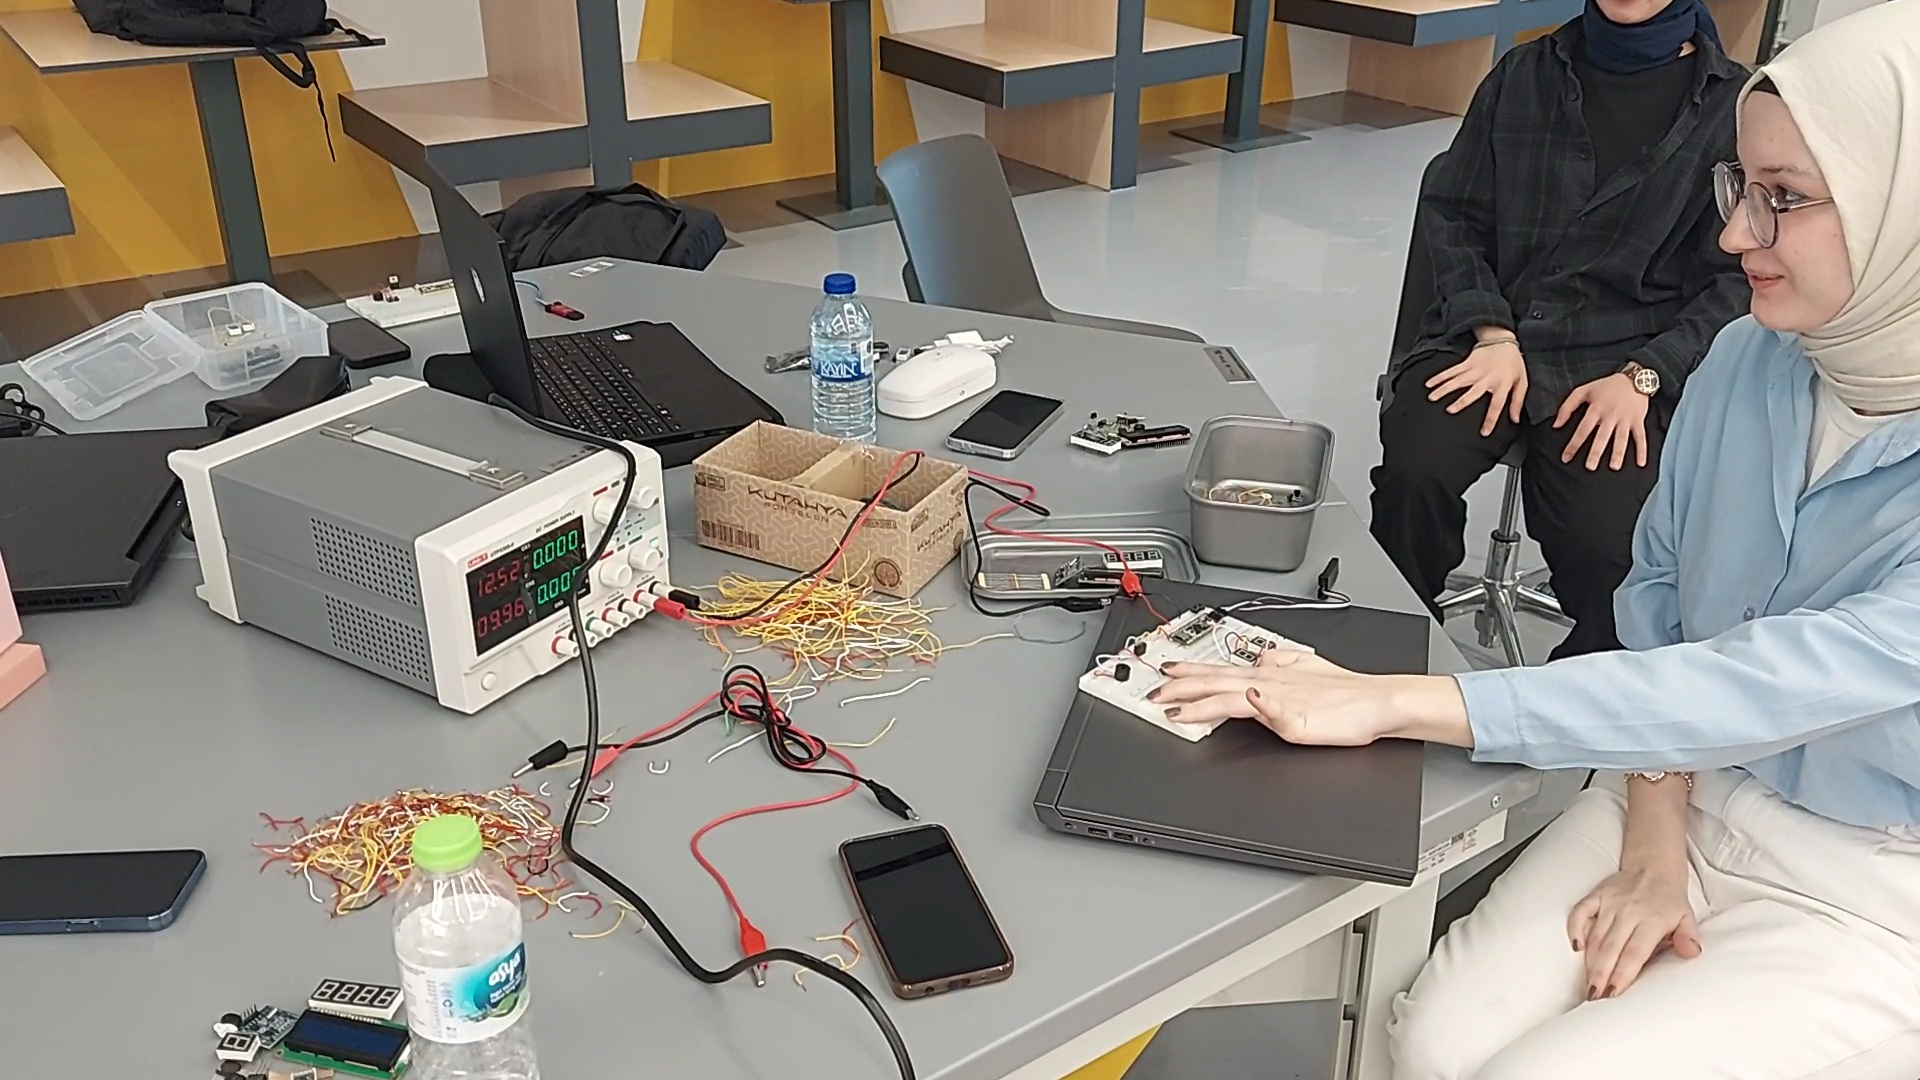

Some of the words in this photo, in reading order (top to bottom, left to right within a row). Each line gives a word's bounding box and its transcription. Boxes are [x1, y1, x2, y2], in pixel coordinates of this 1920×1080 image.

[747, 485, 848, 520] KUTAHYA
[763, 501, 829, 523] PORSELEN
[533, 530, 579, 570] 0.000
[916, 511, 962, 552] KUTAHYA
[478, 560, 520, 597] 12.52
[537, 566, 581, 605] 0.00
[477, 597, 525, 637] 09.96
